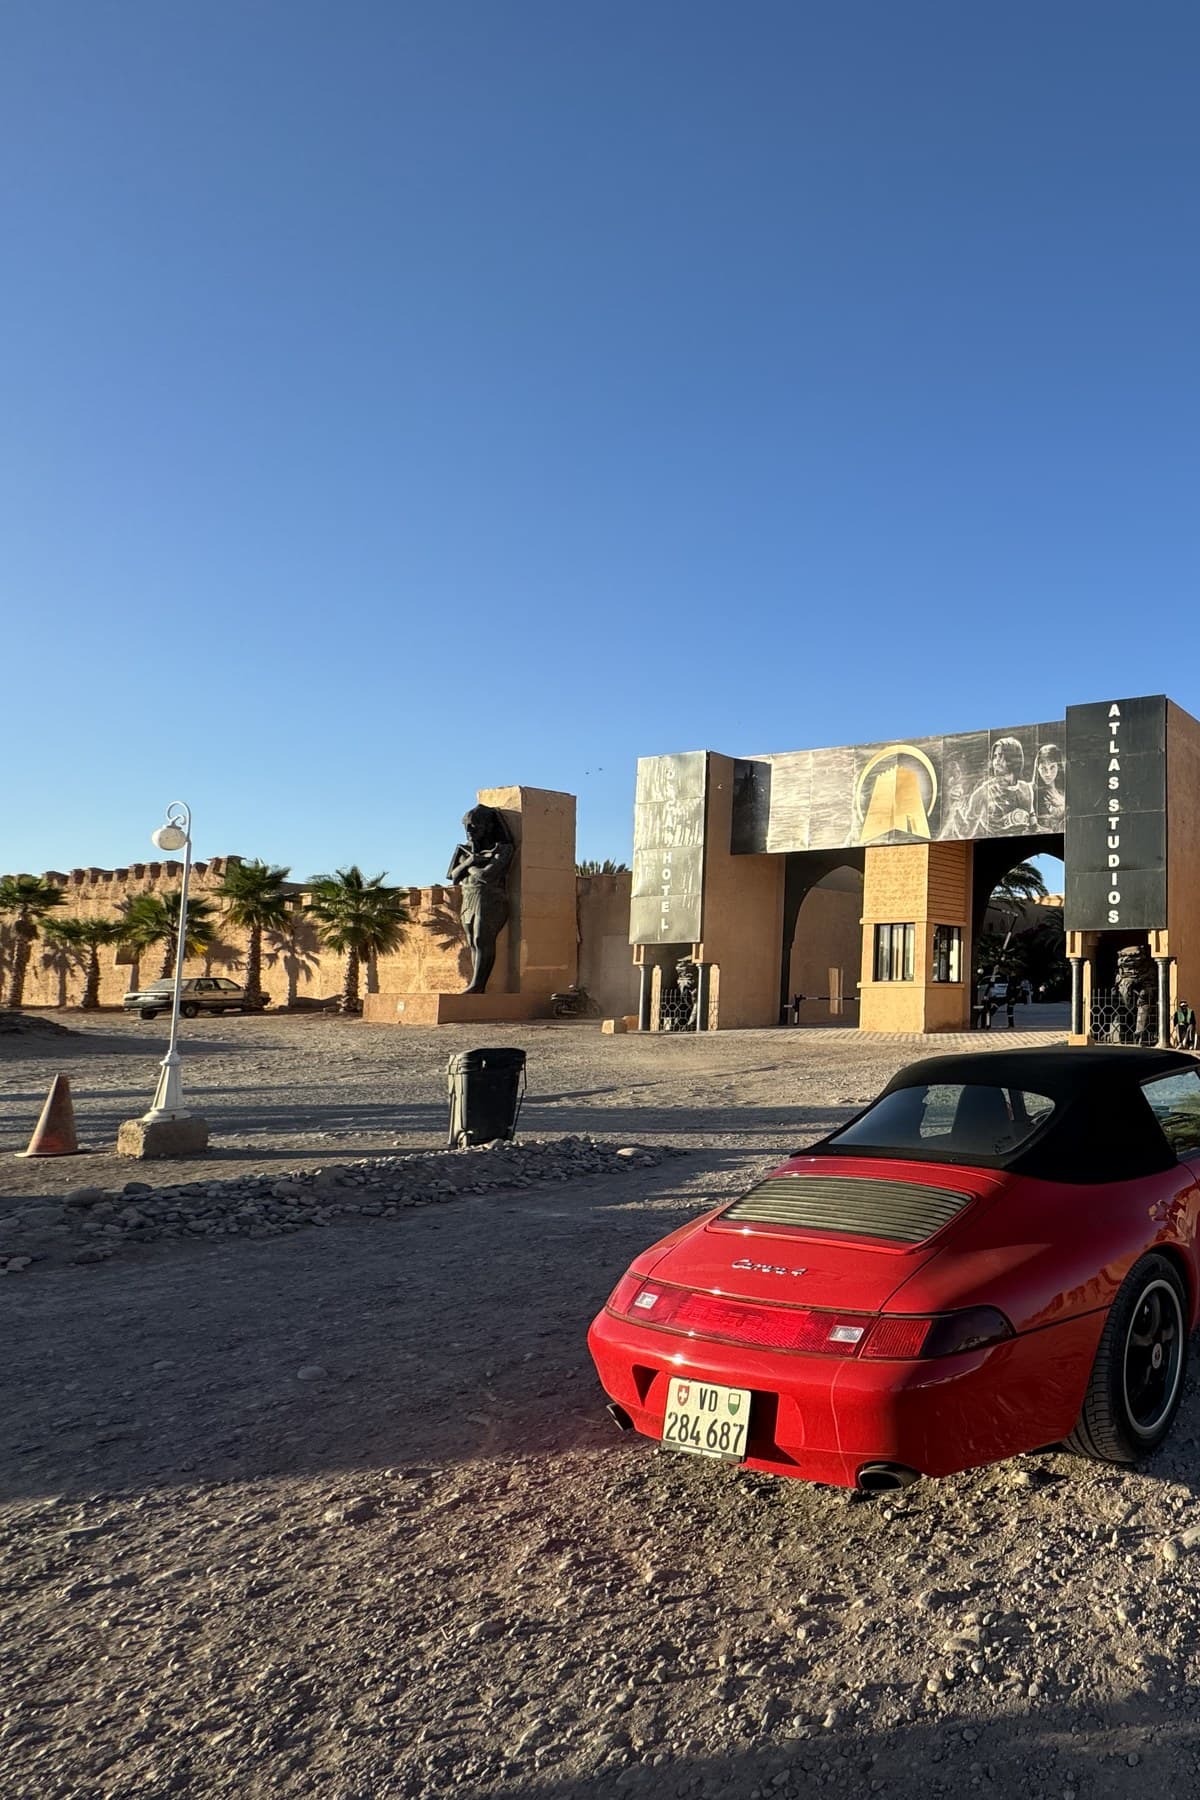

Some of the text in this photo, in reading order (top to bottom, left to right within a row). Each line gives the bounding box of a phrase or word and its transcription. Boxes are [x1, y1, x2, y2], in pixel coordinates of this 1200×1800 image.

[1107, 704, 1121, 924] ATLAS STUDIOS
[660, 852, 672, 931] HOTEL
[699, 1387, 718, 1412] VD
[665, 1411, 744, 1454] 284 687
